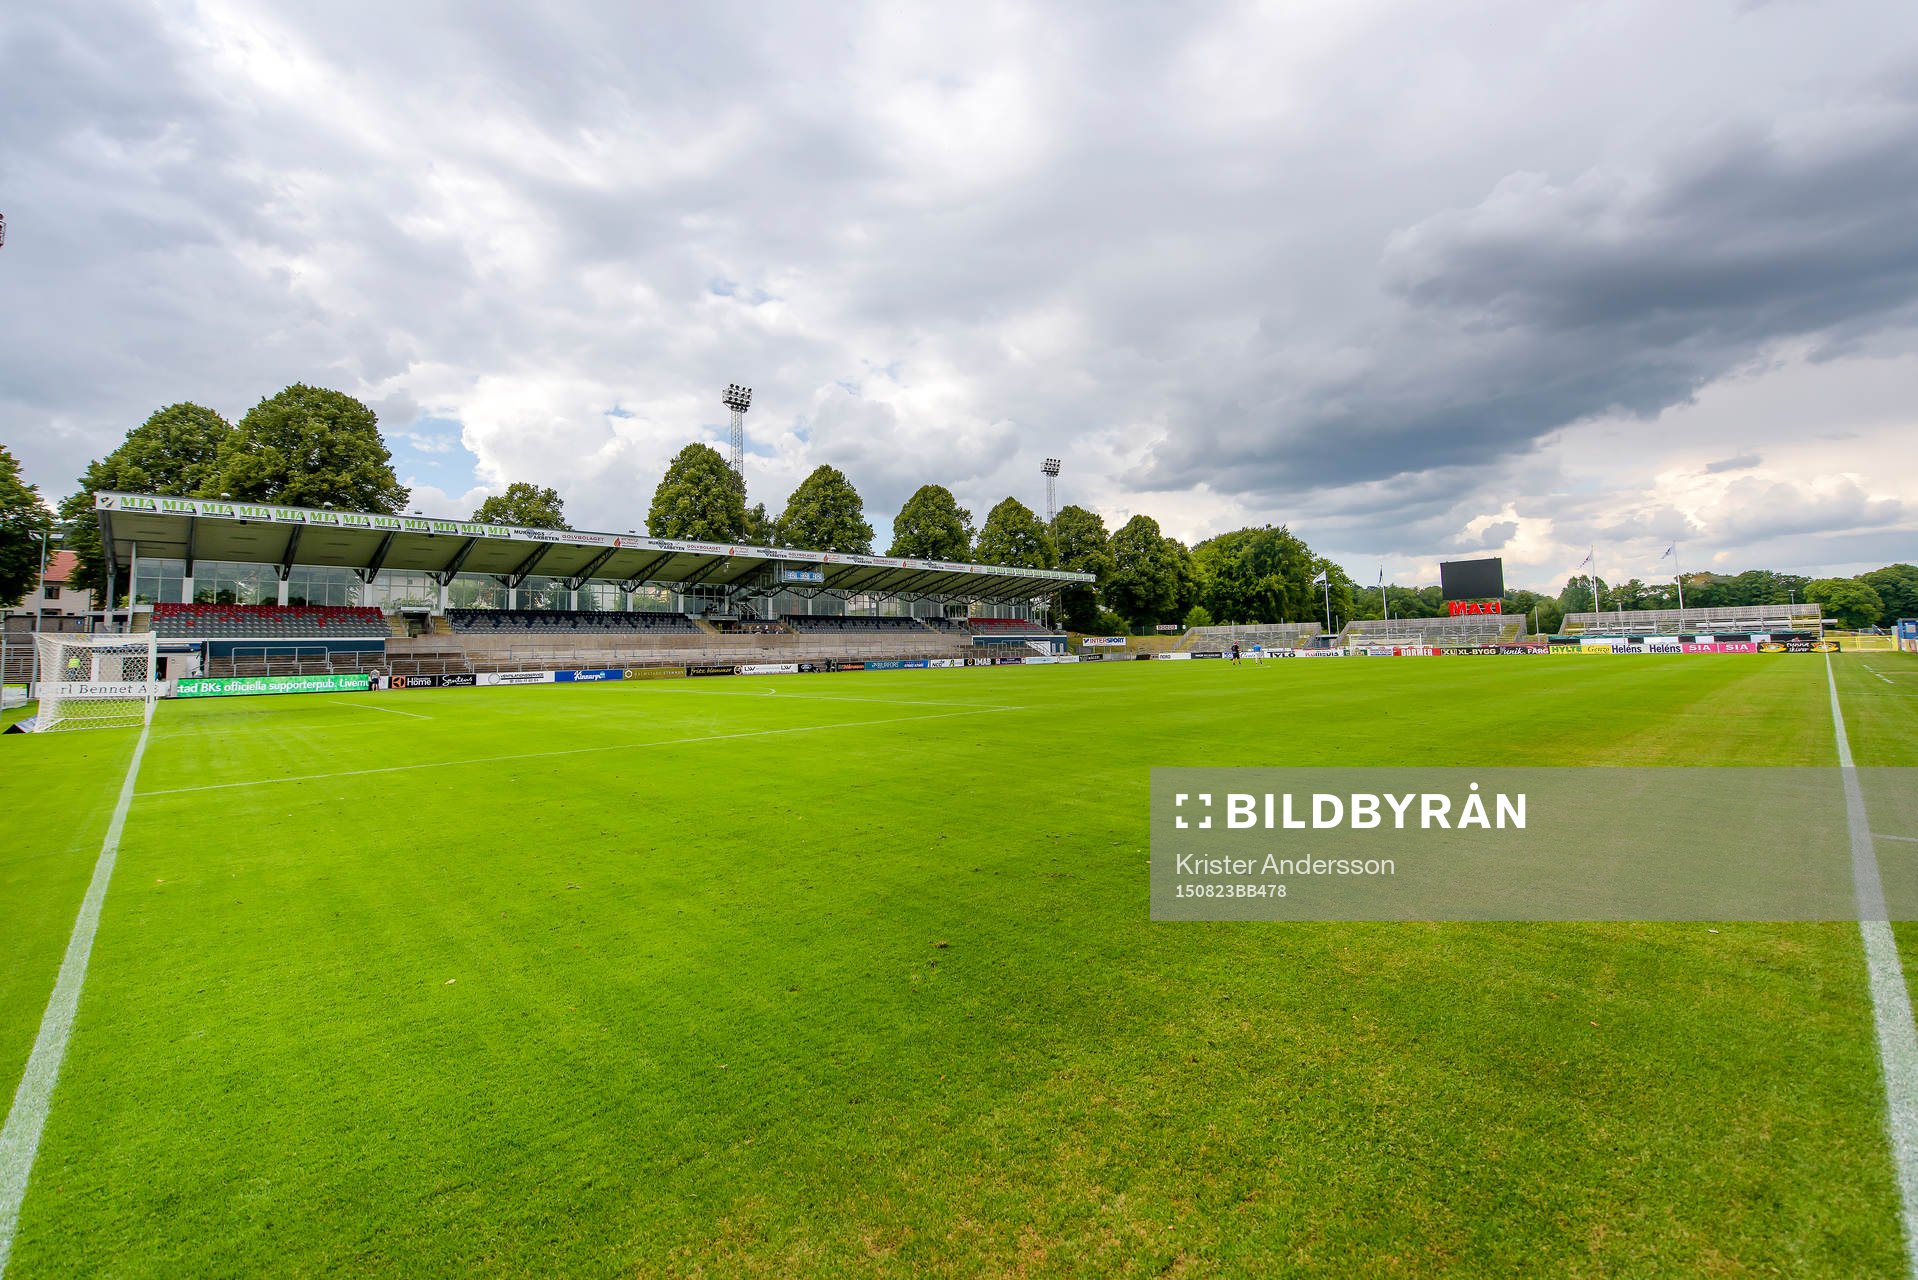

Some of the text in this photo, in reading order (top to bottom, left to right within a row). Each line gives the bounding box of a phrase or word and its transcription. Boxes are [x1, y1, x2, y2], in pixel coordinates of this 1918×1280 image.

[121, 497, 157, 510] MTA
[162, 500, 197, 513] MTA
[202, 503, 235, 516] MTA
[240, 506, 271, 519] MTA
[1448, 600, 1502, 616] MAXI
[1612, 644, 1642, 653] Heléns
[1650, 644, 1681, 653] Heléns
[201, 682, 221, 692] BKs
[224, 681, 266, 691] officiella
[269, 679, 336, 692] supporterpub.
[407, 677, 431, 686] Home
[79, 684, 132, 694] Bennet
